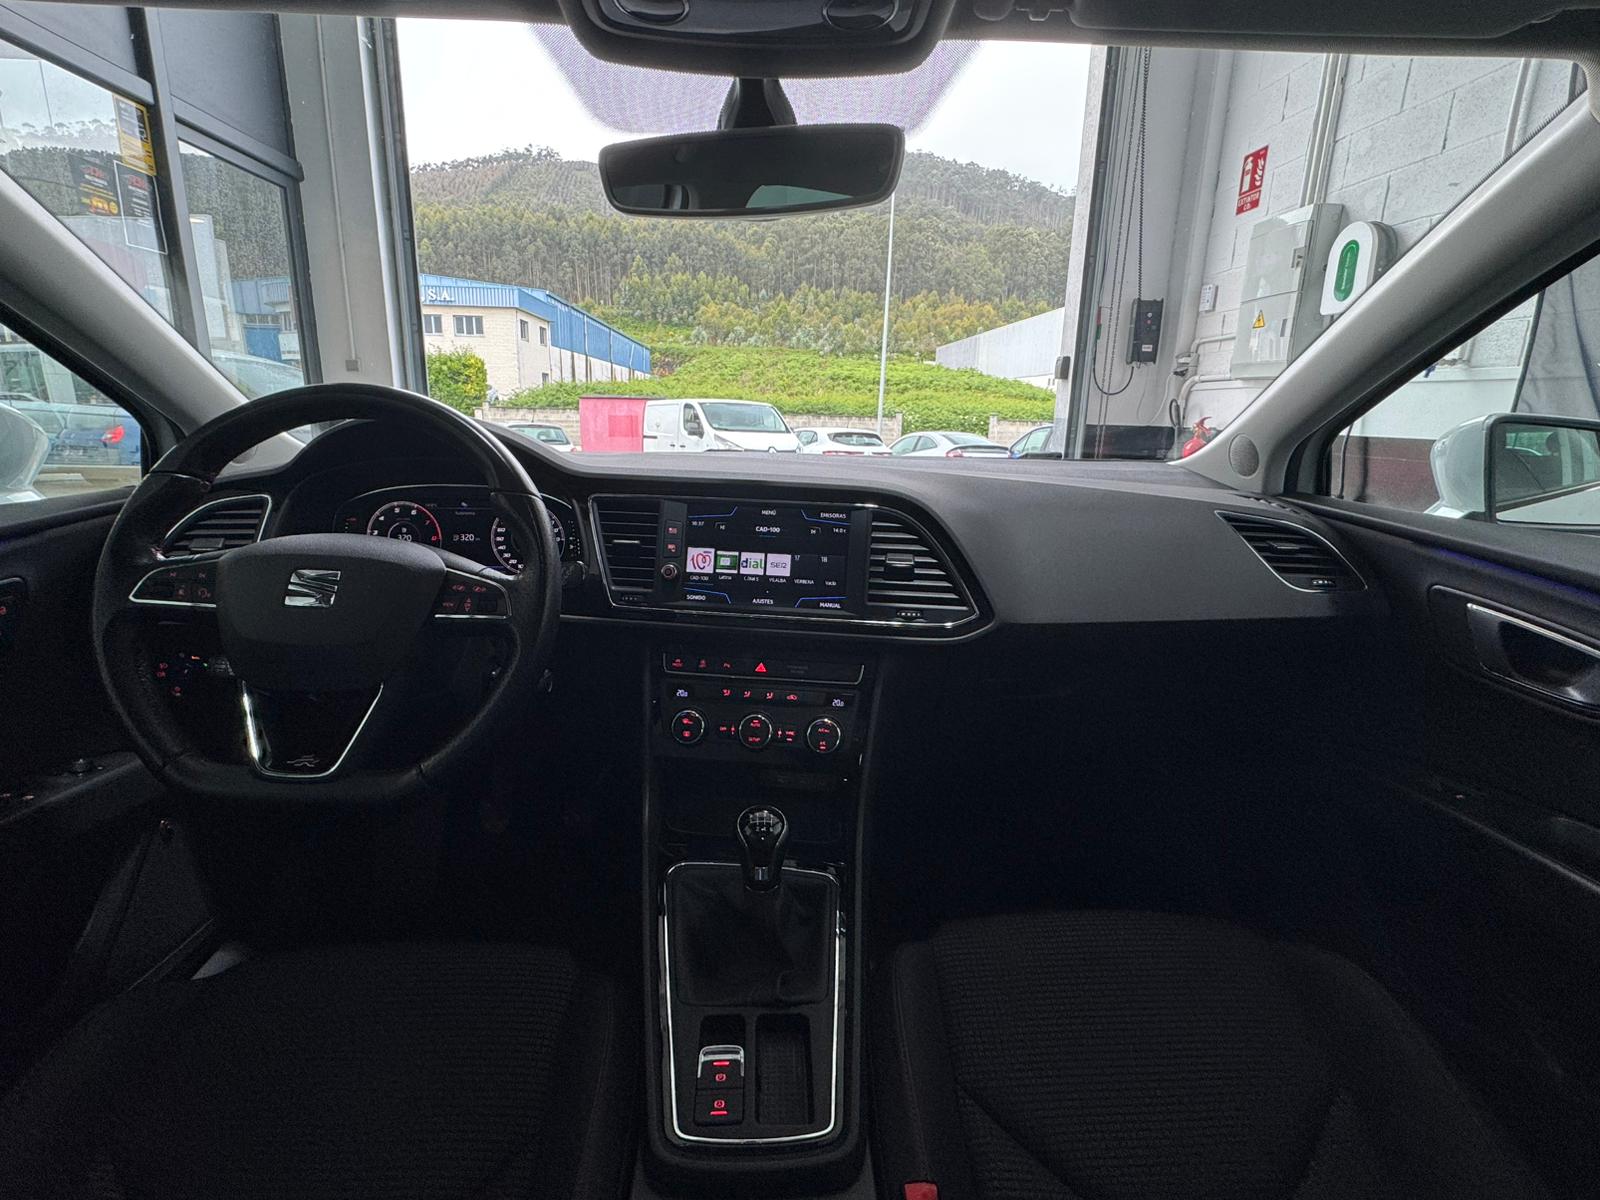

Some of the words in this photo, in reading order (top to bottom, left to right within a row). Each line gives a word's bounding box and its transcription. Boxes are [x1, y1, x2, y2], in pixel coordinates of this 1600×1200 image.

[428, 288, 455, 301] S.A.
[755, 525, 780, 533] CAD-100
[741, 557, 764, 569] dial
